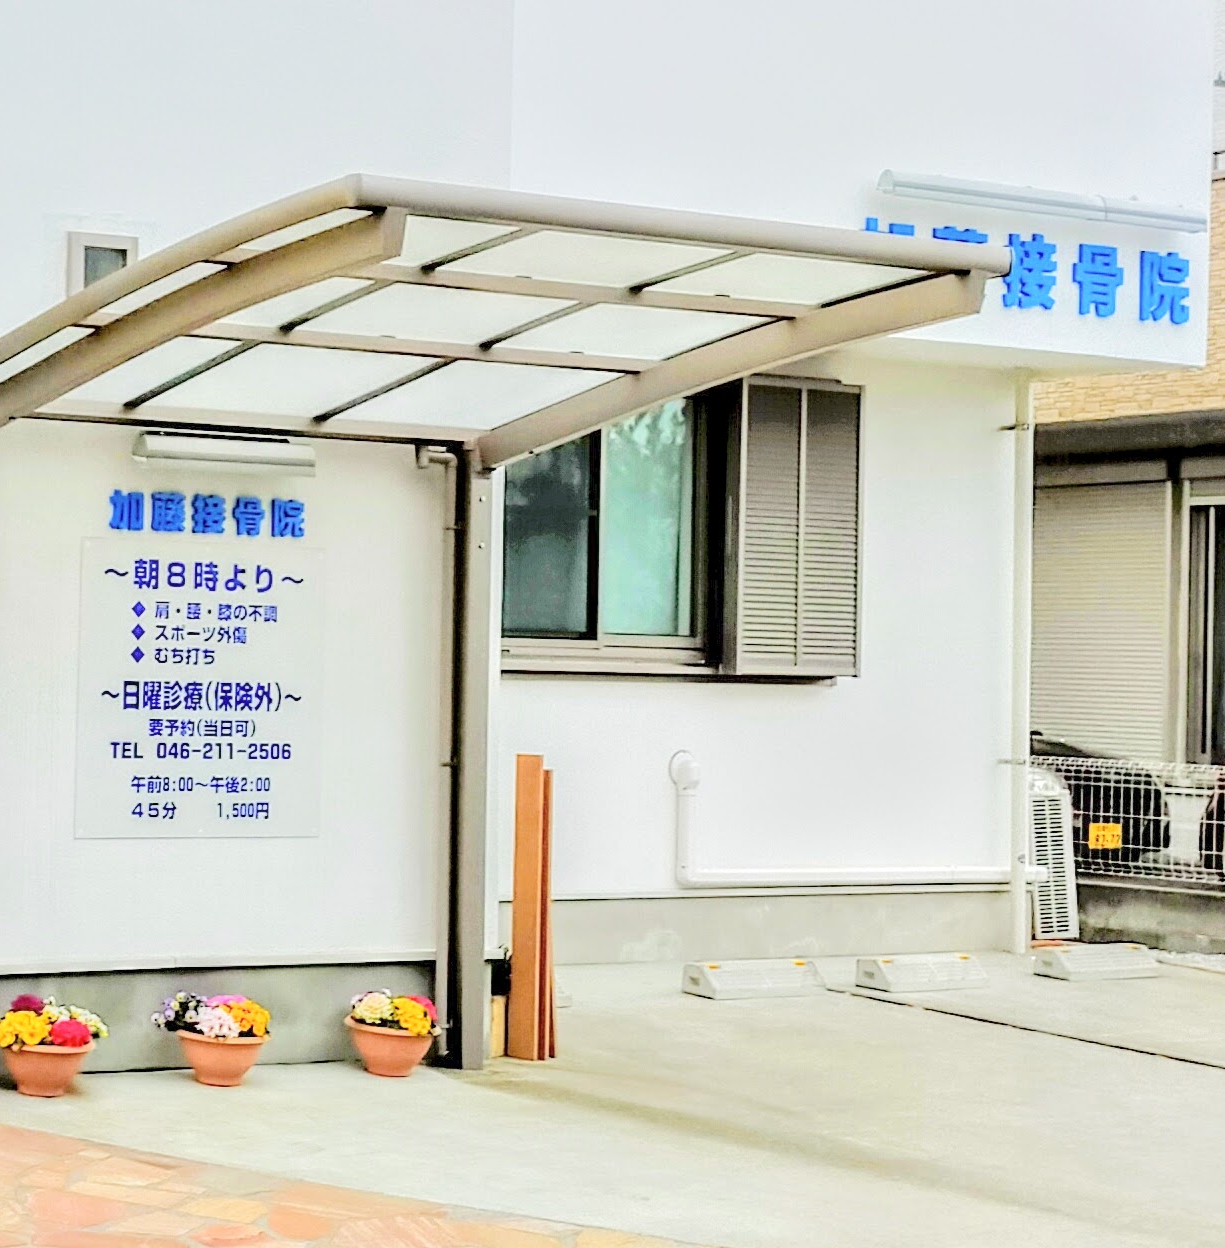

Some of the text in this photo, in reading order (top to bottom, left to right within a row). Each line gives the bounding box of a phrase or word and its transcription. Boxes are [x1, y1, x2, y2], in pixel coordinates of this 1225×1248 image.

[860, 217, 1190, 325] 接骨院
[108, 489, 305, 538] 加藤接骨院
[154, 647, 215, 665] むち打ち
[110, 742, 292, 760] TEL 046-211-2506
[217, 802, 269, 820] 1,500円
